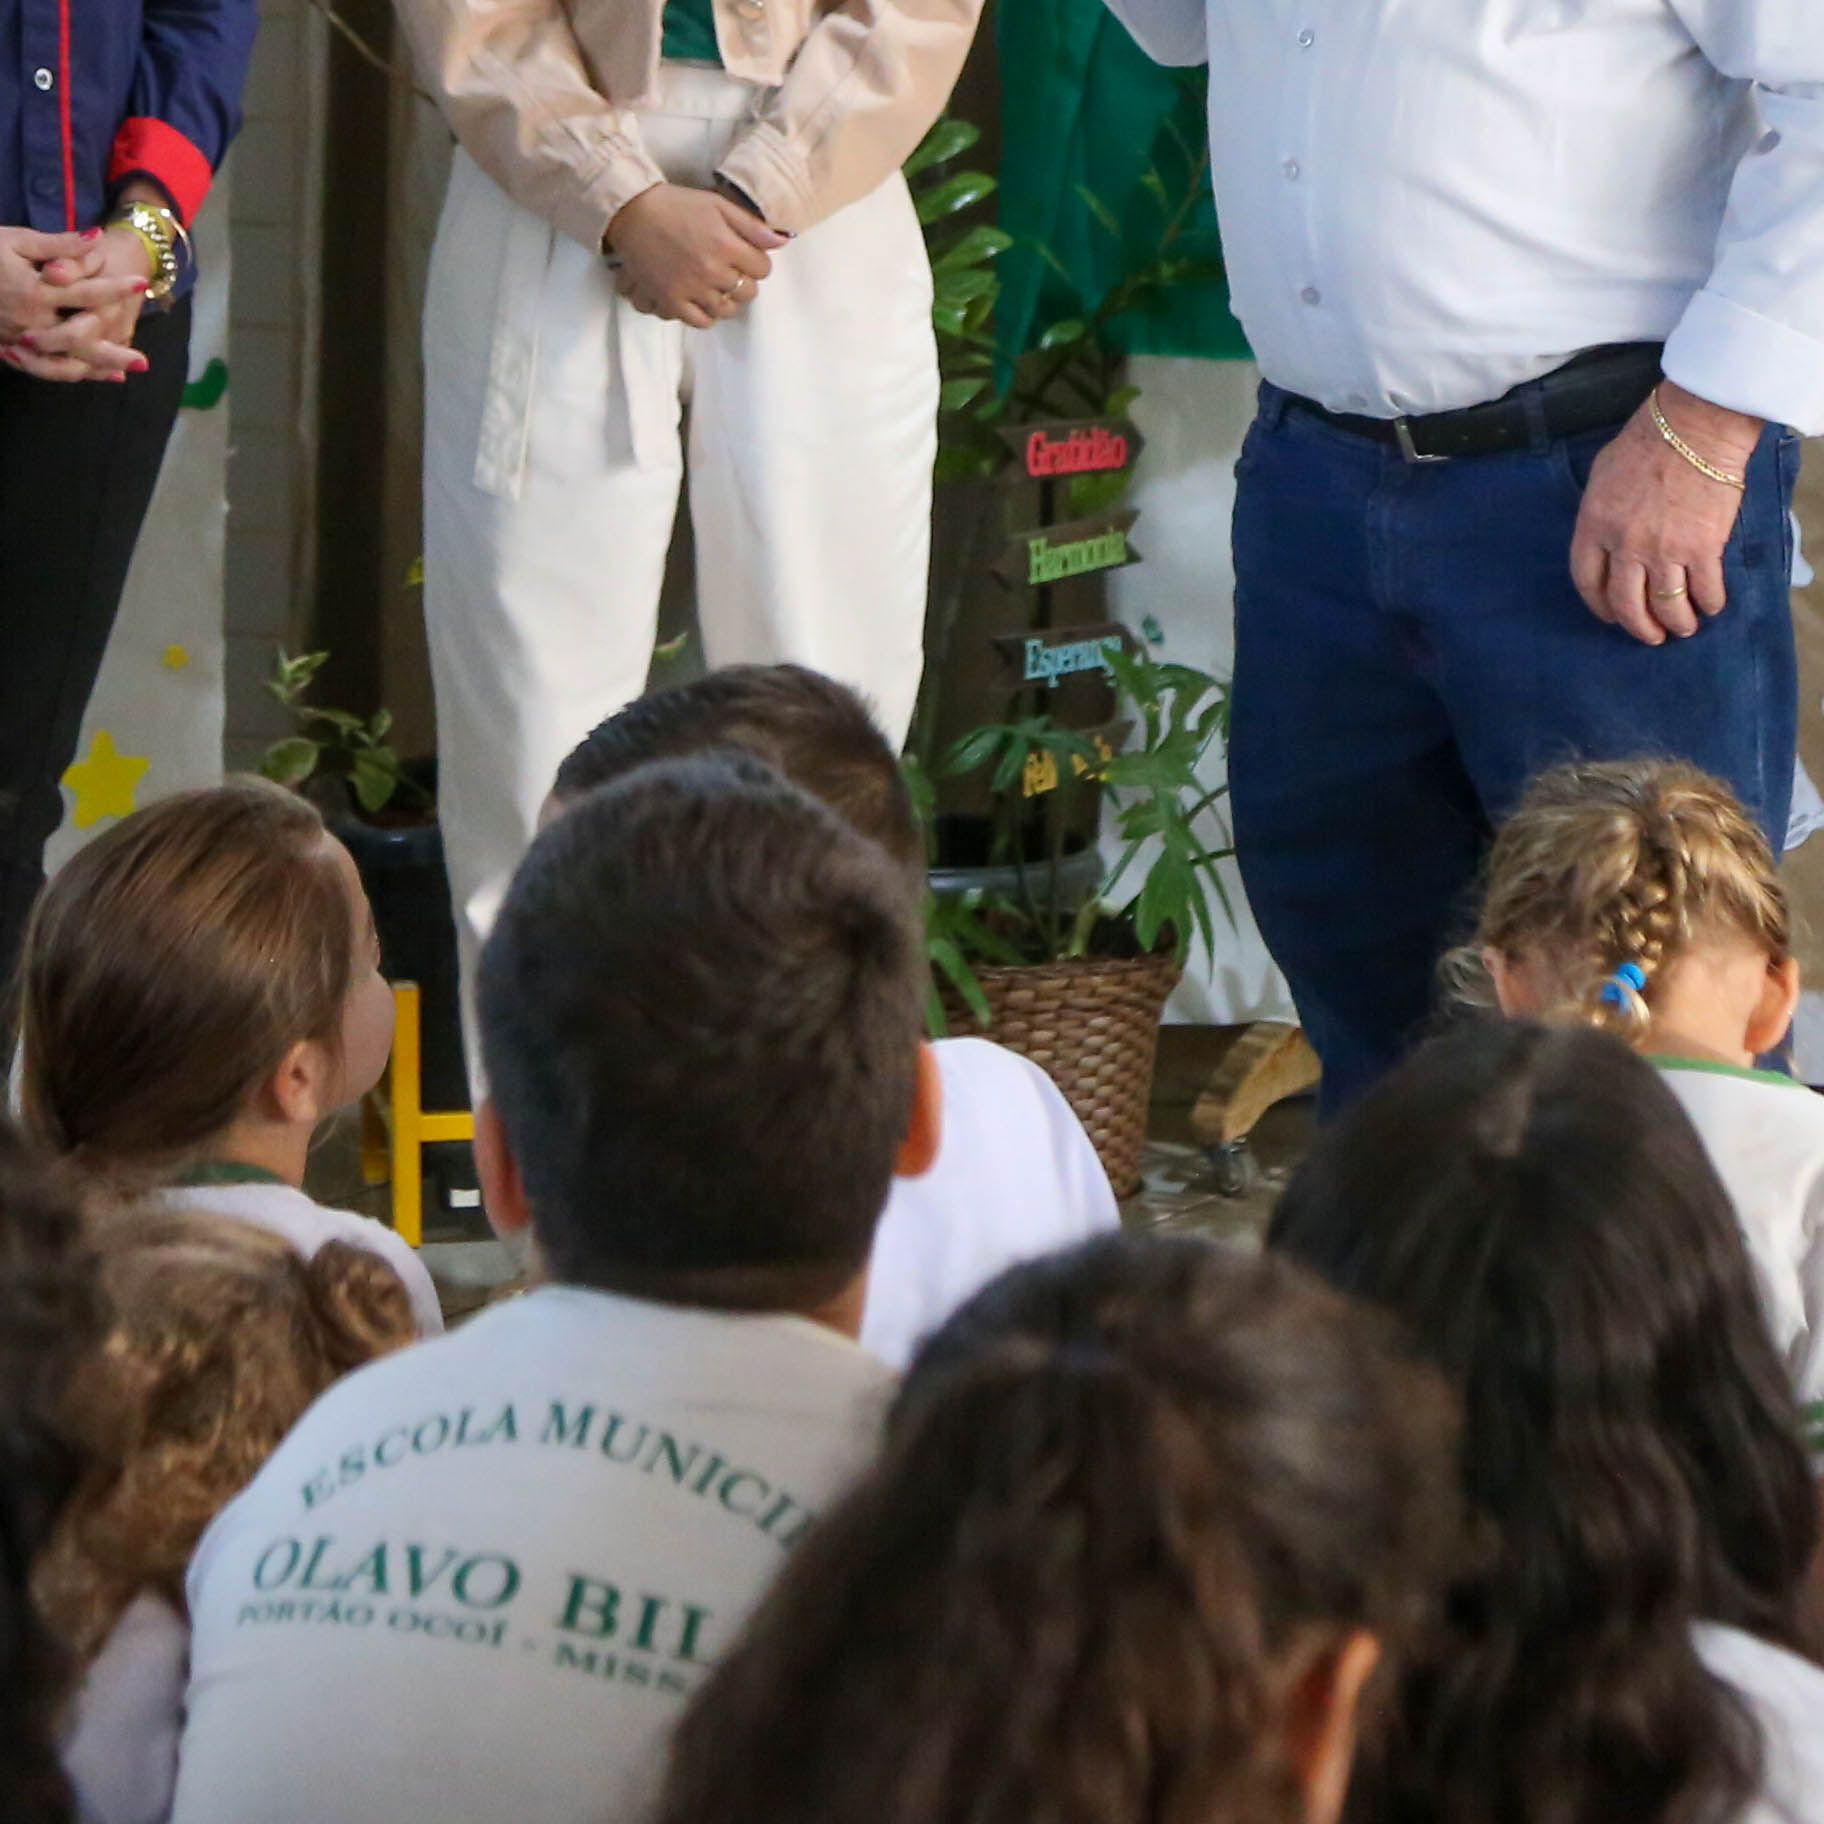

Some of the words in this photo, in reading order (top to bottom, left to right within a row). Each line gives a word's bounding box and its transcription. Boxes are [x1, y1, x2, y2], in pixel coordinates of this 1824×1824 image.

[300, 1402, 519, 1516] ESCOLA
[253, 1534, 521, 1612] OLAVO
[237, 1599, 374, 1628] PORTÃO
